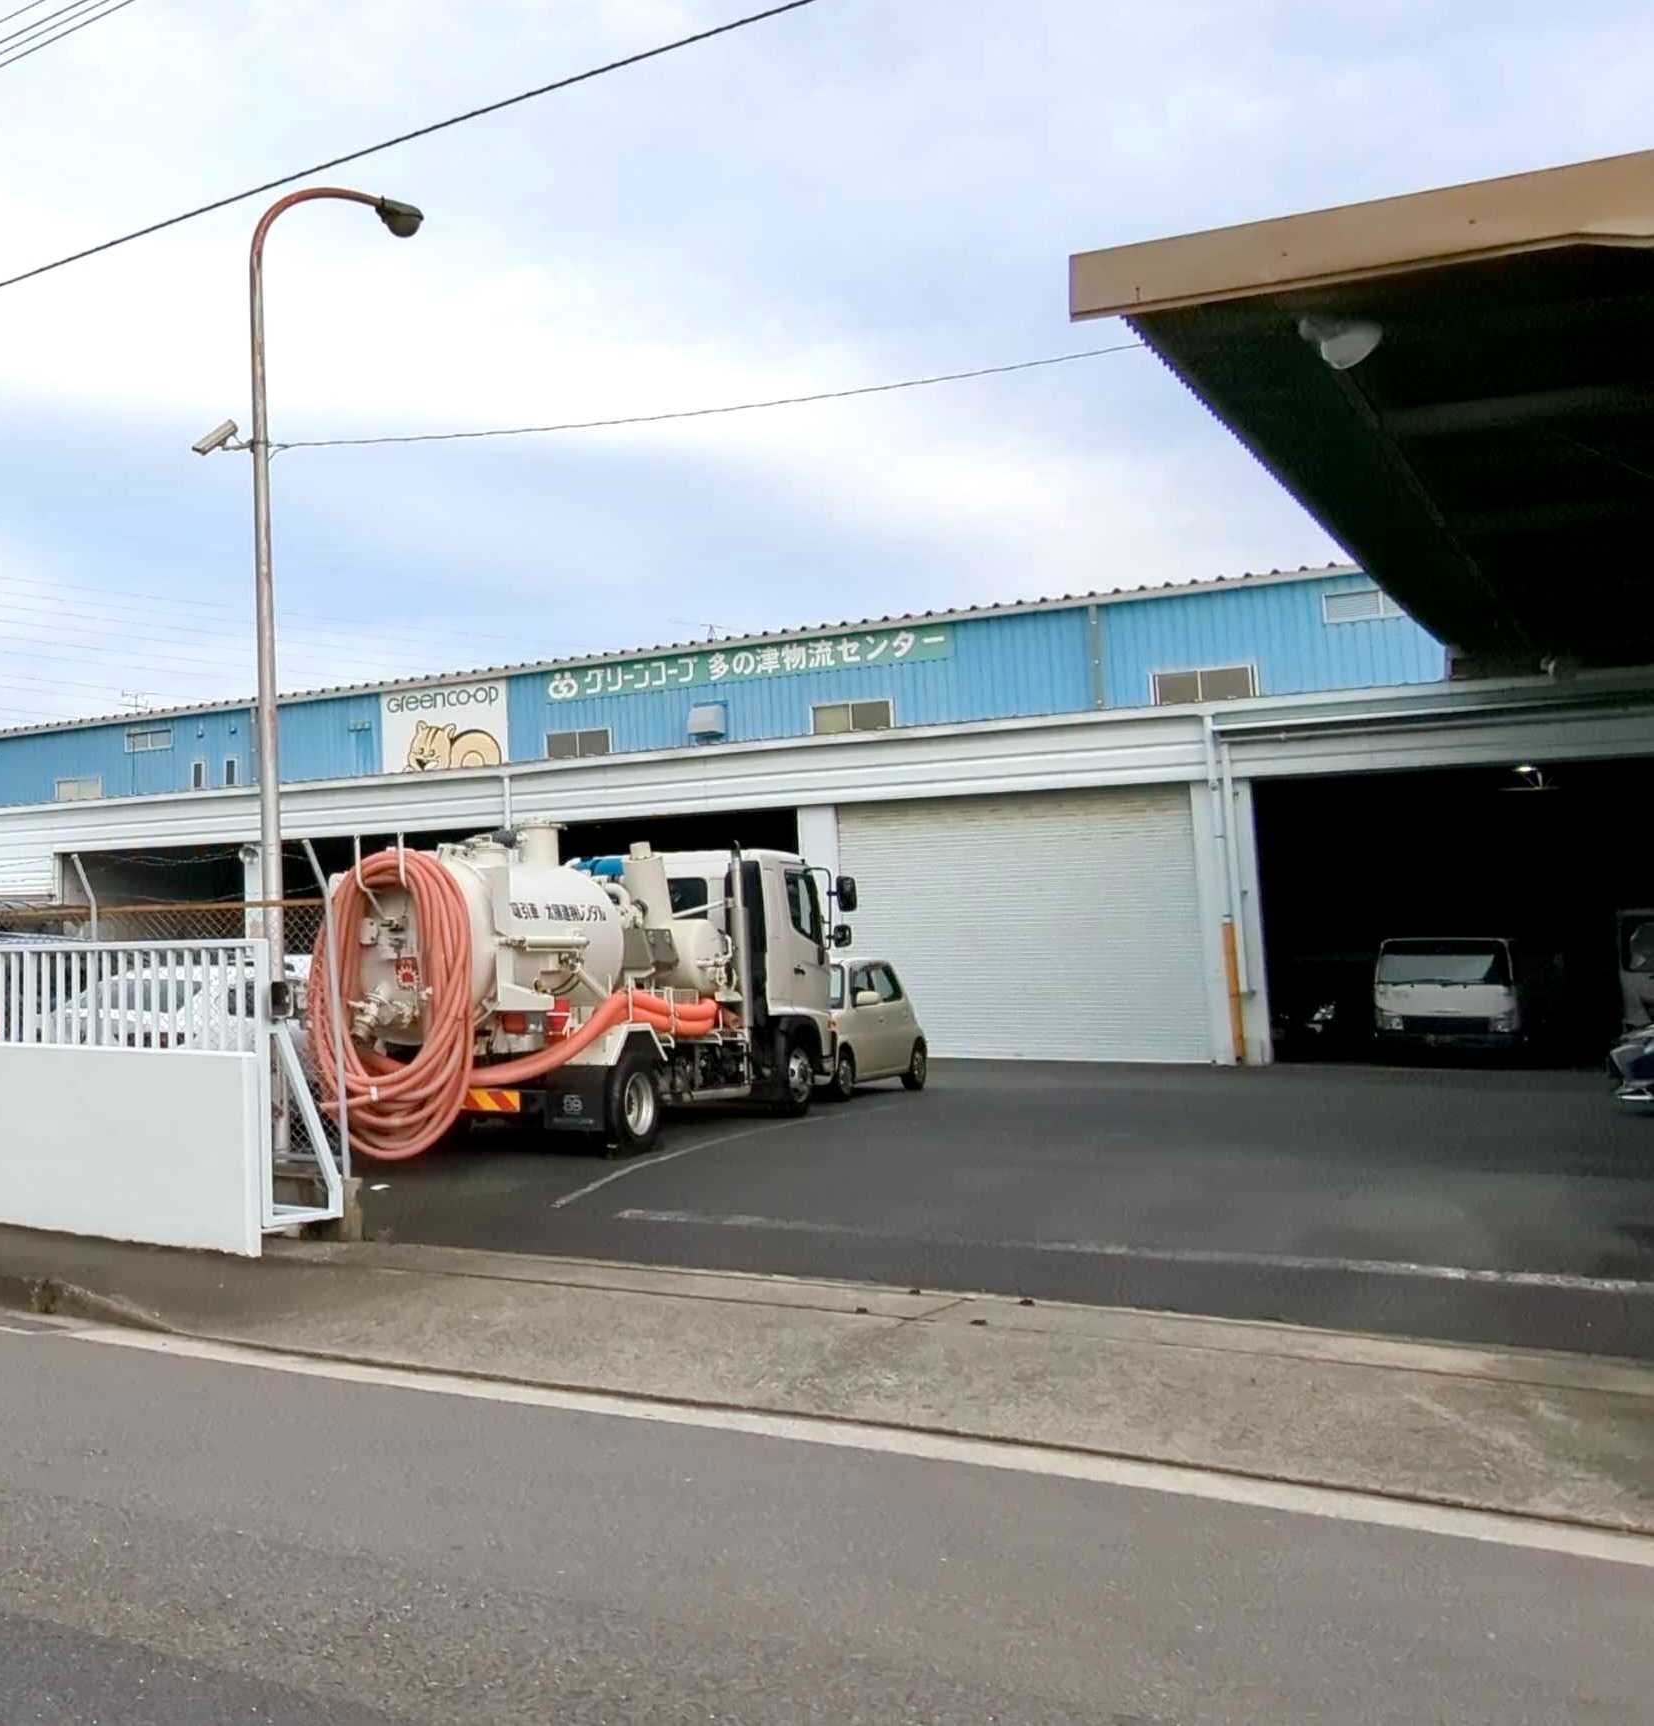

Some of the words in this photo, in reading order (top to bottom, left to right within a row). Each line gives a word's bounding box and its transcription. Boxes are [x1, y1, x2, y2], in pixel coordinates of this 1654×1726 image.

[584, 656, 698, 695] グリーンコープ
[708, 630, 946, 681] 多の津物流センター
